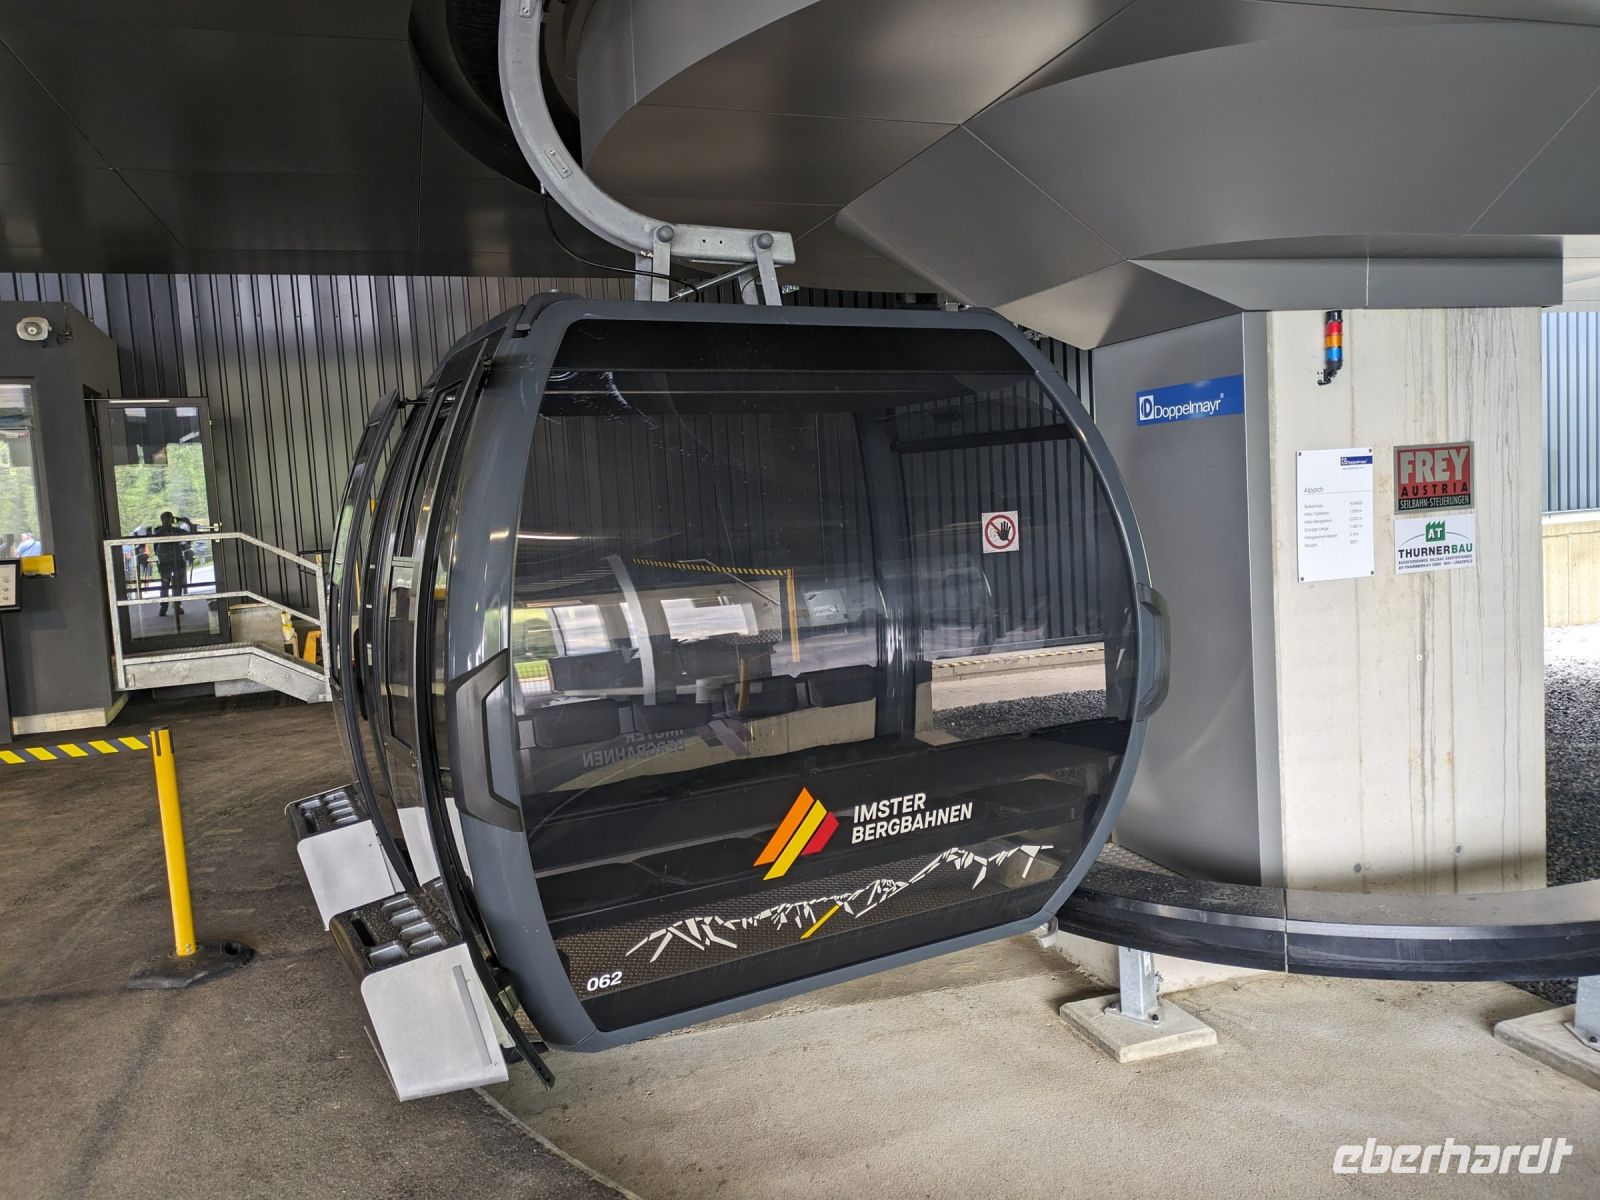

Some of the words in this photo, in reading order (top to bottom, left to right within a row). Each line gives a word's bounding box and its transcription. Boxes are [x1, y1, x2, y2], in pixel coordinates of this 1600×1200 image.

[1154, 399, 1221, 420] Doppelmayr
[1401, 448, 1468, 484] FREY
[1401, 482, 1468, 497] AUSTRIA
[1400, 495, 1470, 510] SEILBAHN-STEUERUNGEN
[1428, 527, 1443, 539] AT
[1398, 543, 1473, 559] THURNERBAU
[854, 793, 926, 823] IMSTER
[852, 802, 973, 844] BERGBAHNEN
[587, 971, 622, 991] 062
